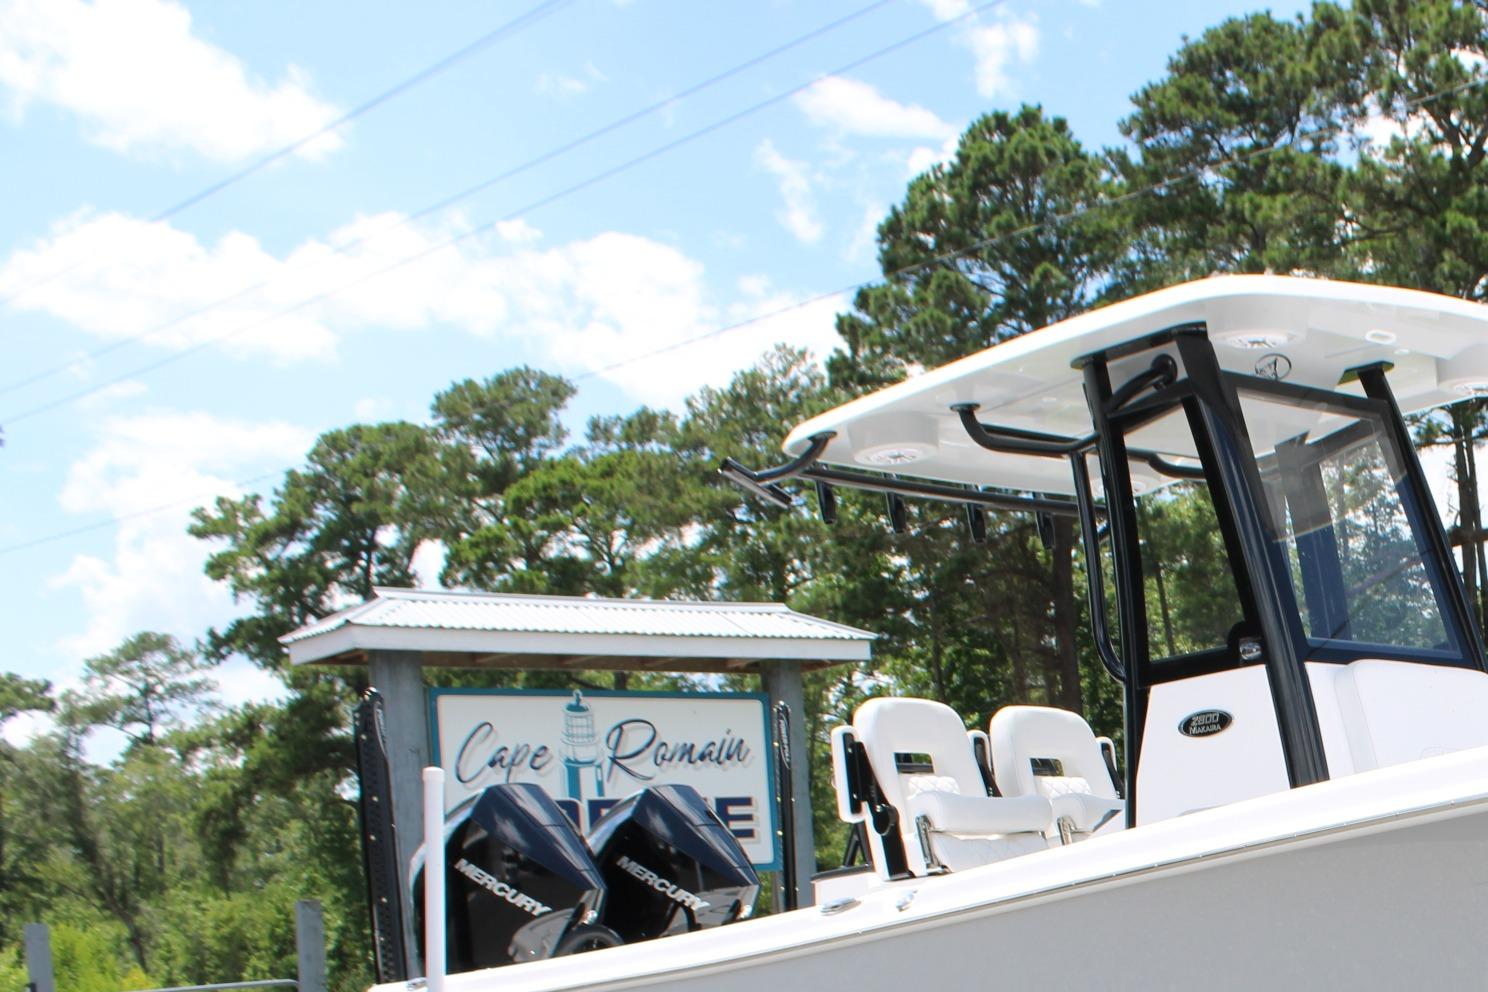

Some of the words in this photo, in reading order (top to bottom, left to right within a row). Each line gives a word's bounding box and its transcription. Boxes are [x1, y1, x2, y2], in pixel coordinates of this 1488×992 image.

[455, 721, 551, 784] Cape
[605, 718, 750, 783] Romain
[454, 858, 552, 917] MERCURY
[615, 855, 711, 912] MERCURY
